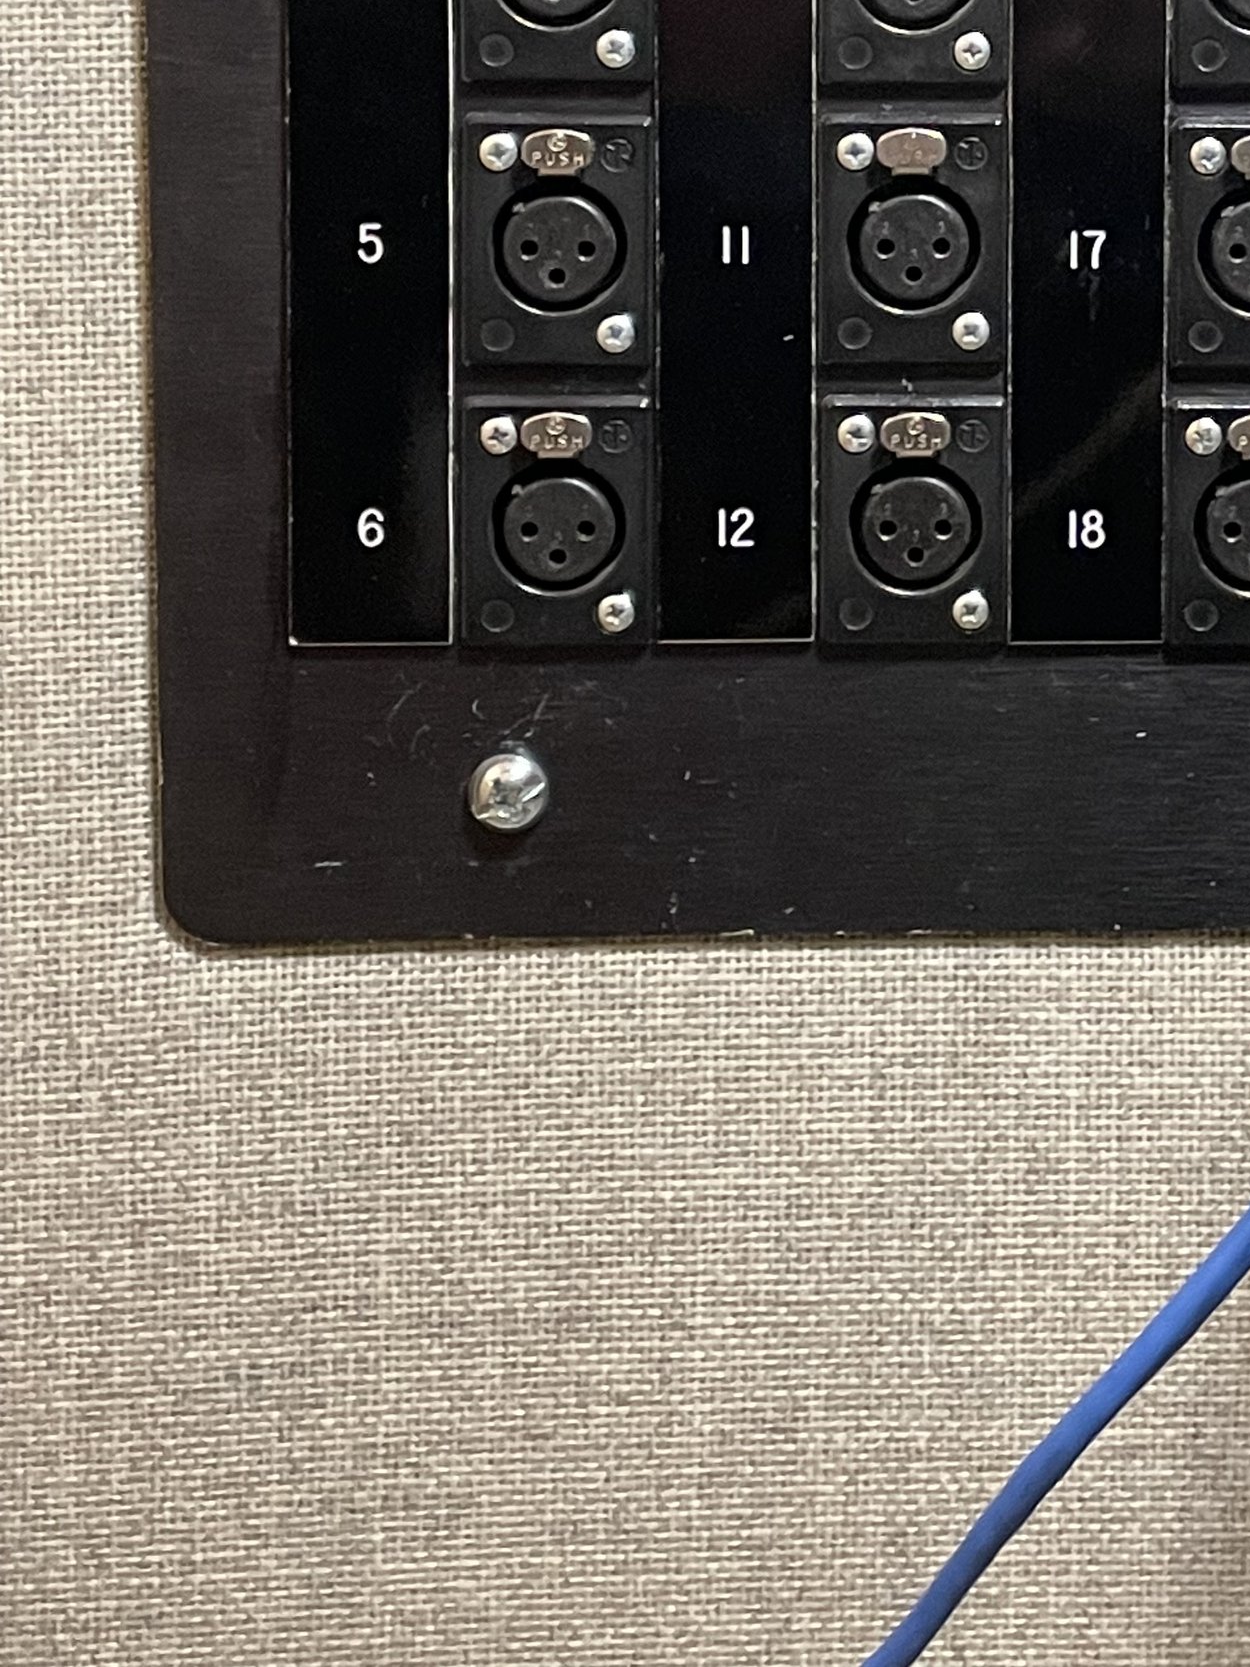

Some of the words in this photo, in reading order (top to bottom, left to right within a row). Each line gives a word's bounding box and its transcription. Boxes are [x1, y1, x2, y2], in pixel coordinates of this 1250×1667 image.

[532, 151, 585, 167] PUSH
[357, 222, 384, 264] 5
[722, 225, 750, 265] 11
[1069, 229, 1107, 270] 17
[530, 434, 584, 450] PUSH
[890, 433, 942, 449] PUSH
[357, 507, 385, 548] 6
[717, 507, 755, 548] 12
[1068, 509, 1106, 549] 18
